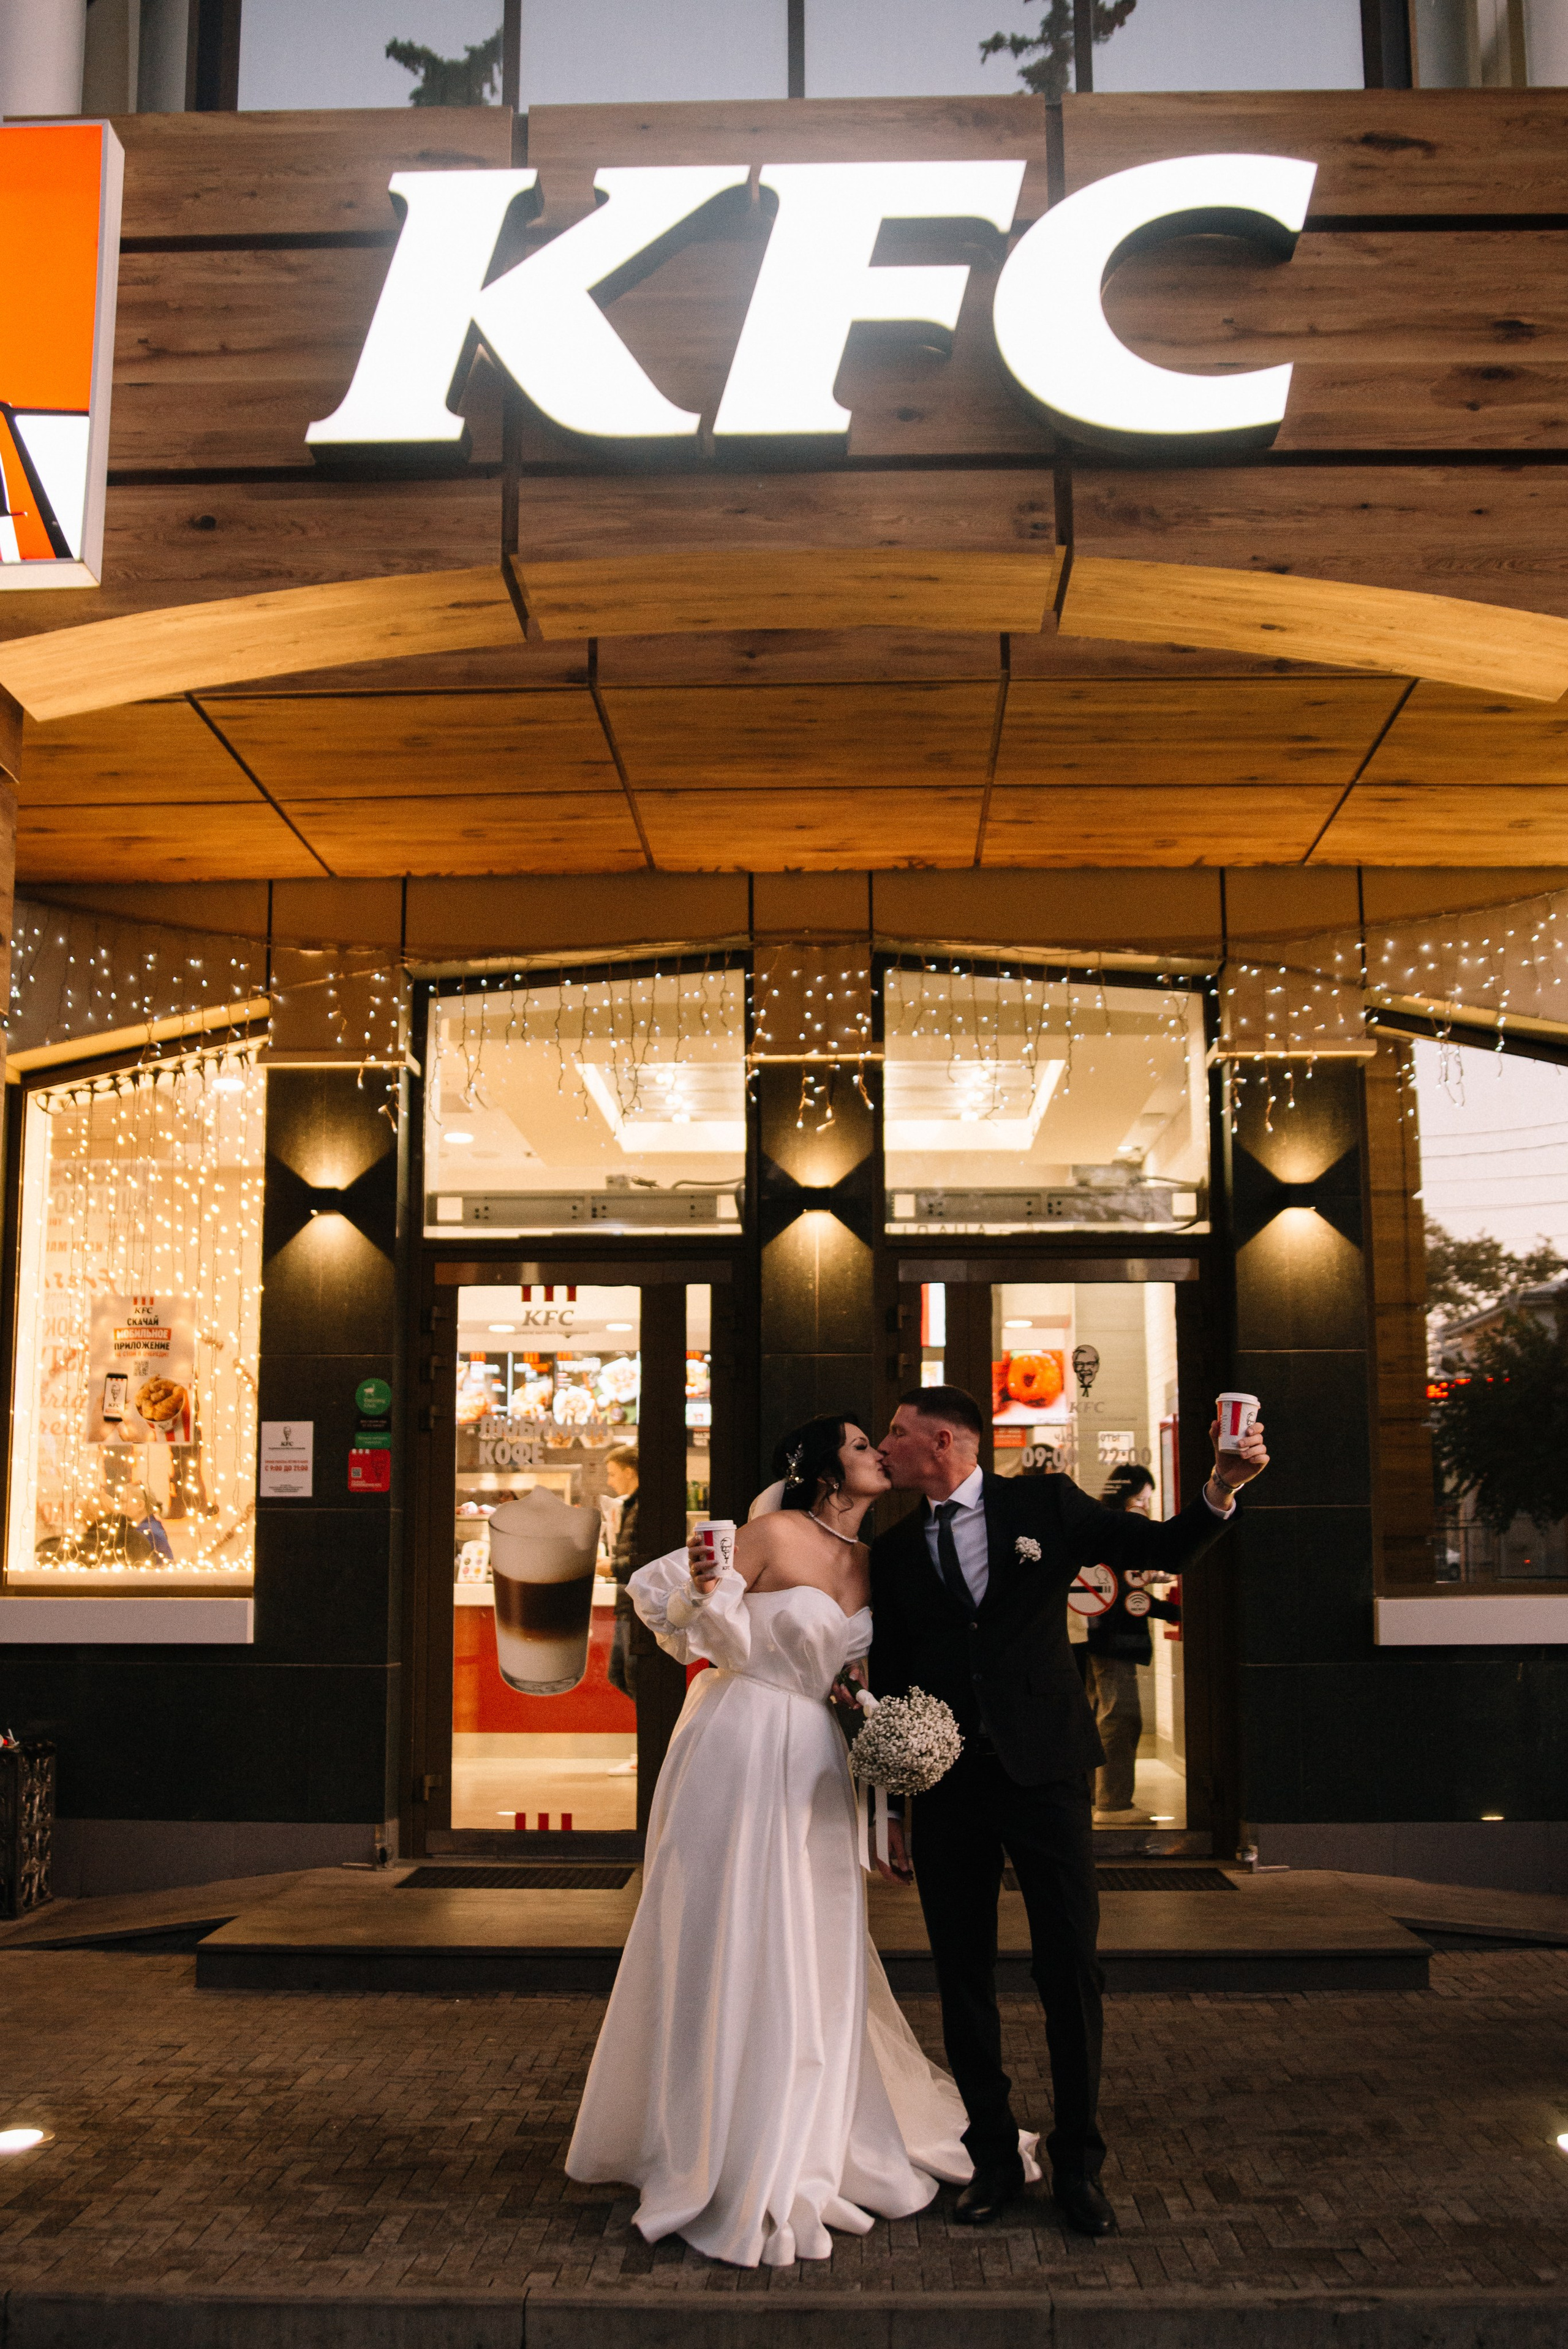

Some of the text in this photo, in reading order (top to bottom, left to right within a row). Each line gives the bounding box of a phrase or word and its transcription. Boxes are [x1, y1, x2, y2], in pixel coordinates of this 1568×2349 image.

[305, 154, 1318, 442] KFC
[127, 1314, 159, 1326] СКАЧАЙ
[521, 1310, 574, 1326] KFC
[116, 1329, 168, 1339] МОБИЛЬНОЕ
[114, 1341, 170, 1351] ПРИЛОЖЕНИЕ
[1068, 1401, 1105, 1413] KFC
[479, 1414, 608, 1437] ЛЮБИМЫЙ
[479, 1441, 546, 1465] КОФЕ
[1021, 1447, 1152, 1468] 09:00 22:00
